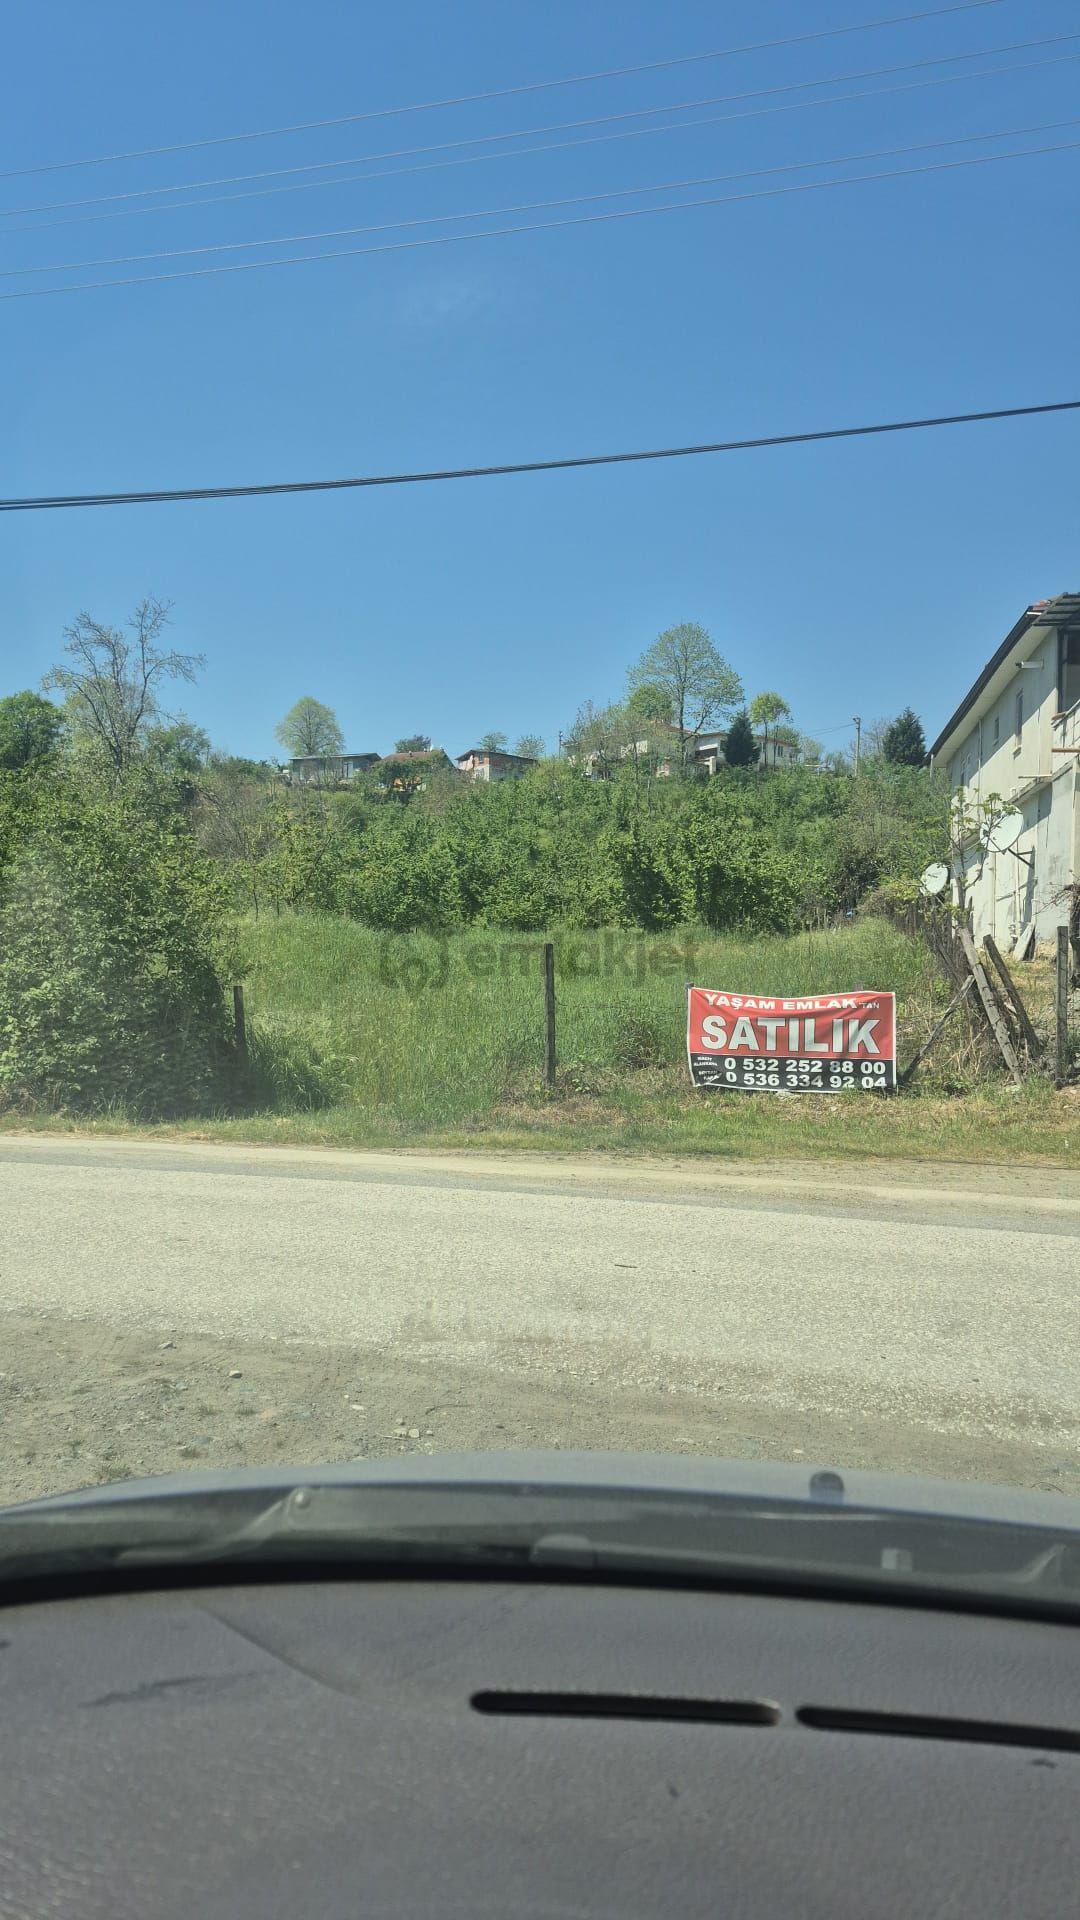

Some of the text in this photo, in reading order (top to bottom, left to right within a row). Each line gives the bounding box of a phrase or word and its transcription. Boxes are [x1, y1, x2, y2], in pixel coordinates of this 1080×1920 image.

[704, 993, 776, 1010] YAŞAM
[701, 1015, 881, 1054] SATILIK
[724, 1057, 737, 1070] 0
[742, 1058, 780, 1072] 532
[785, 1059, 823, 1073] 252
[829, 1060, 854, 1074] 88
[860, 1061, 886, 1075] 00
[725, 1071, 738, 1083] 0
[743, 1072, 780, 1087] 536
[786, 1074, 824, 1088] 334
[829, 1075, 855, 1088] 92
[861, 1076, 888, 1089] 04
